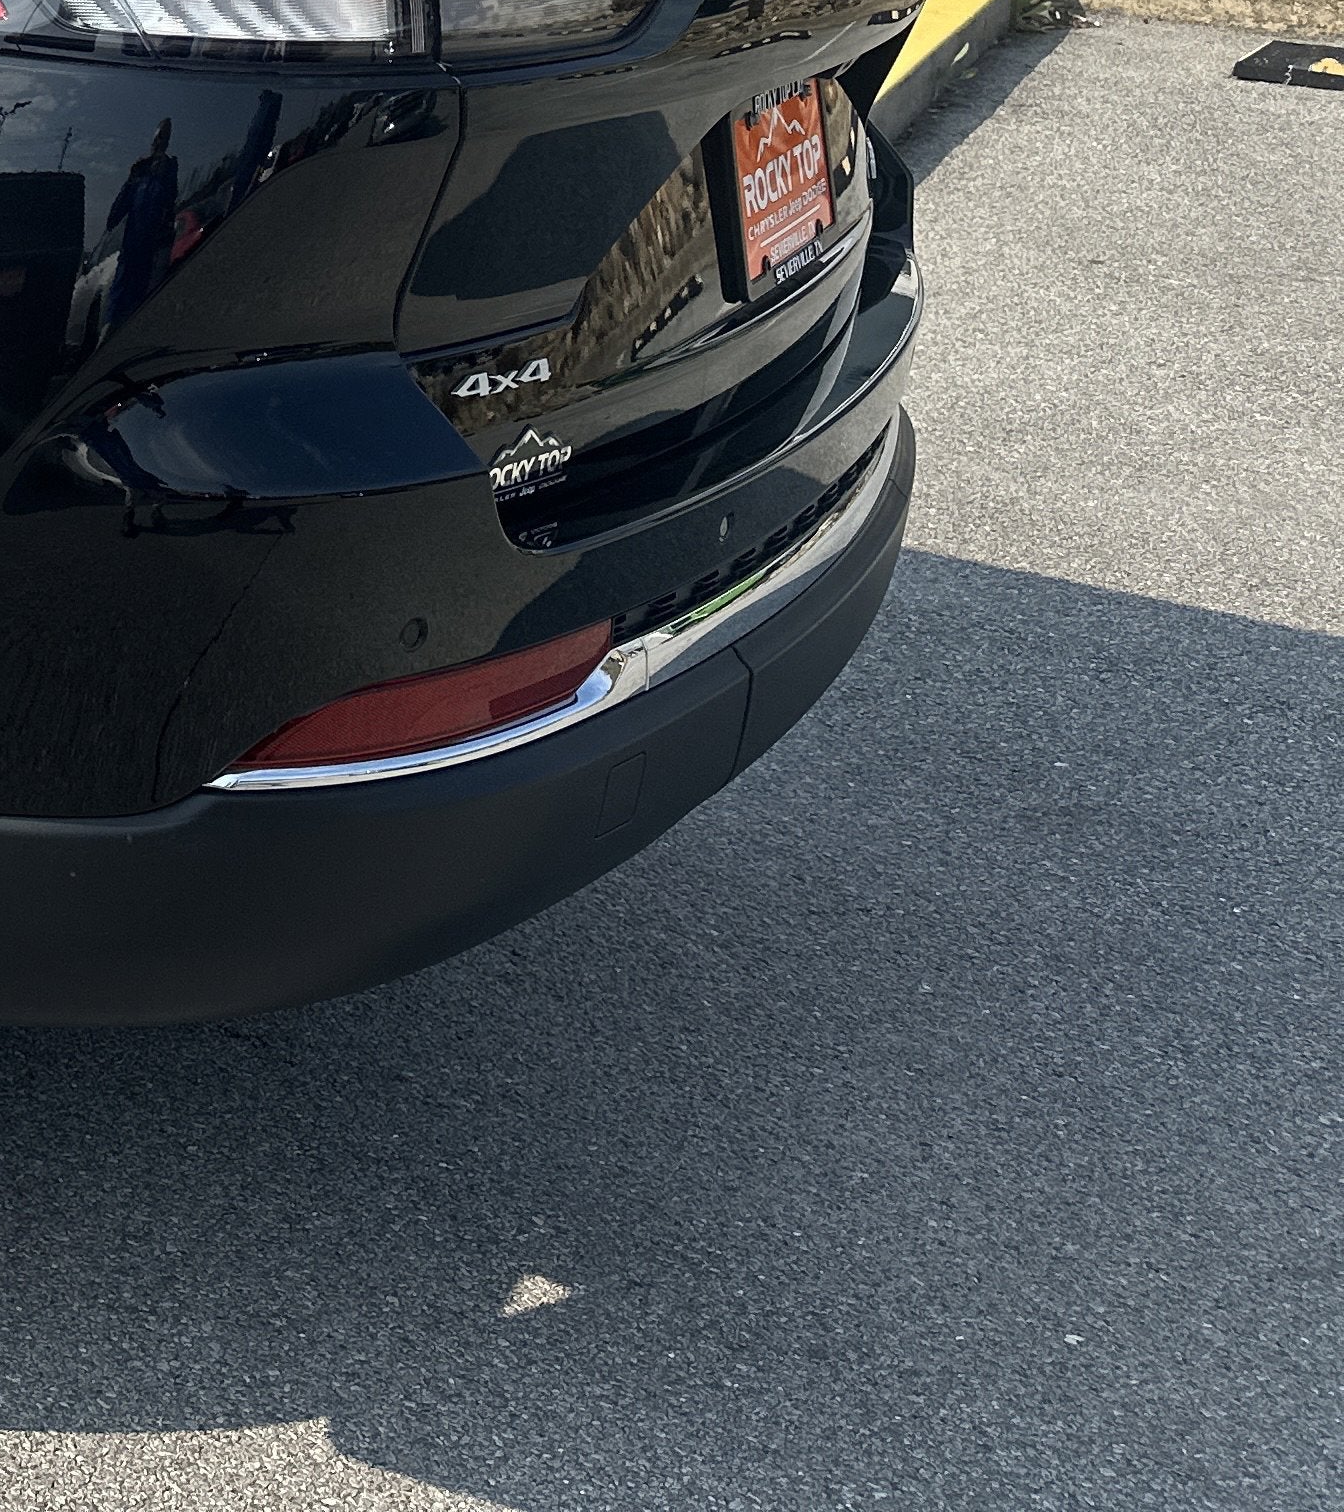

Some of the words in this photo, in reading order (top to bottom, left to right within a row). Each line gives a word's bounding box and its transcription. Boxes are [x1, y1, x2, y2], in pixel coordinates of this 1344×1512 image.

[743, 153, 792, 218] ROCKY
[794, 135, 821, 184] TOP
[748, 206, 788, 241] CHRYSLER
[451, 357, 552, 397] 4x4
[489, 456, 536, 490] OCKY
[538, 445, 572, 477] TOP
